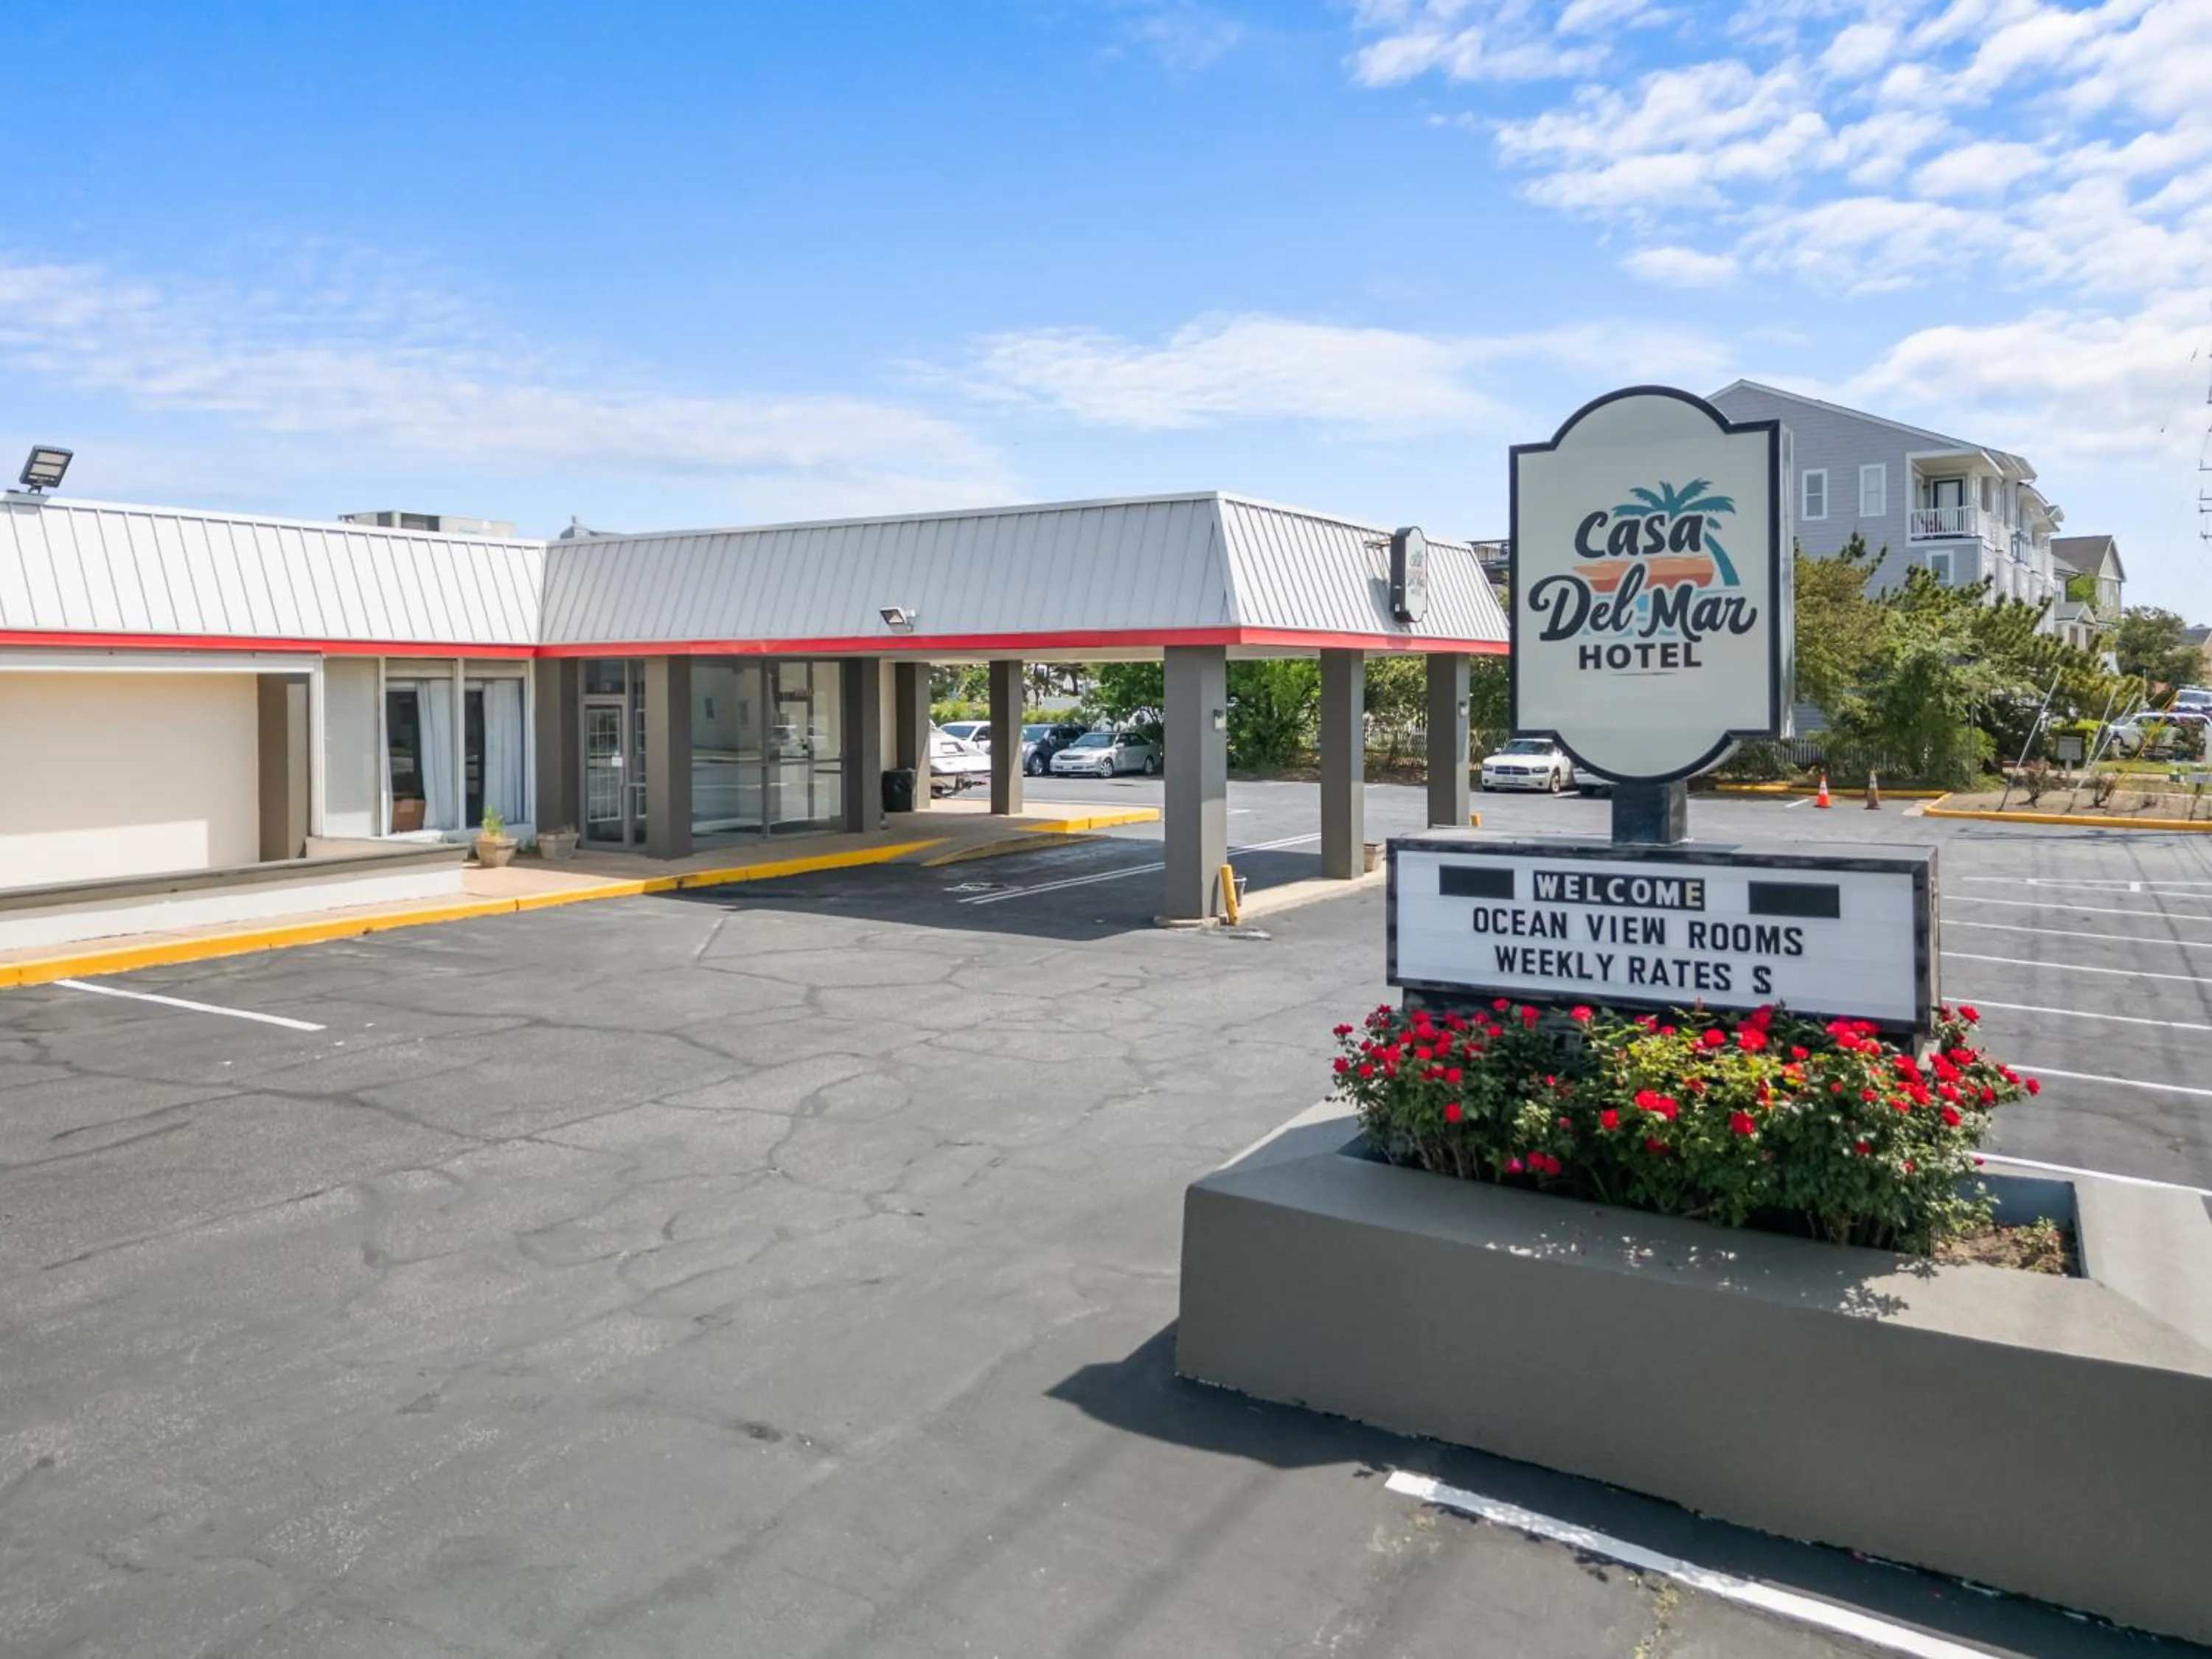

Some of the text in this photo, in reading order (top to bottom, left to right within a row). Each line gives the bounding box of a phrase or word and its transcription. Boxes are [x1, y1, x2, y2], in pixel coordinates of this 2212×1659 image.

[1574, 511, 1704, 558] Casa
[1528, 563, 1757, 642] Del Mar
[1579, 642, 1702, 669] HOTEL
[1536, 874, 1701, 907] WELCOME
[1473, 908, 1803, 956] OCEAN VIEW ROOMS
[1495, 945, 1615, 981] WEEKLY
[1628, 956, 1731, 991] RATES
